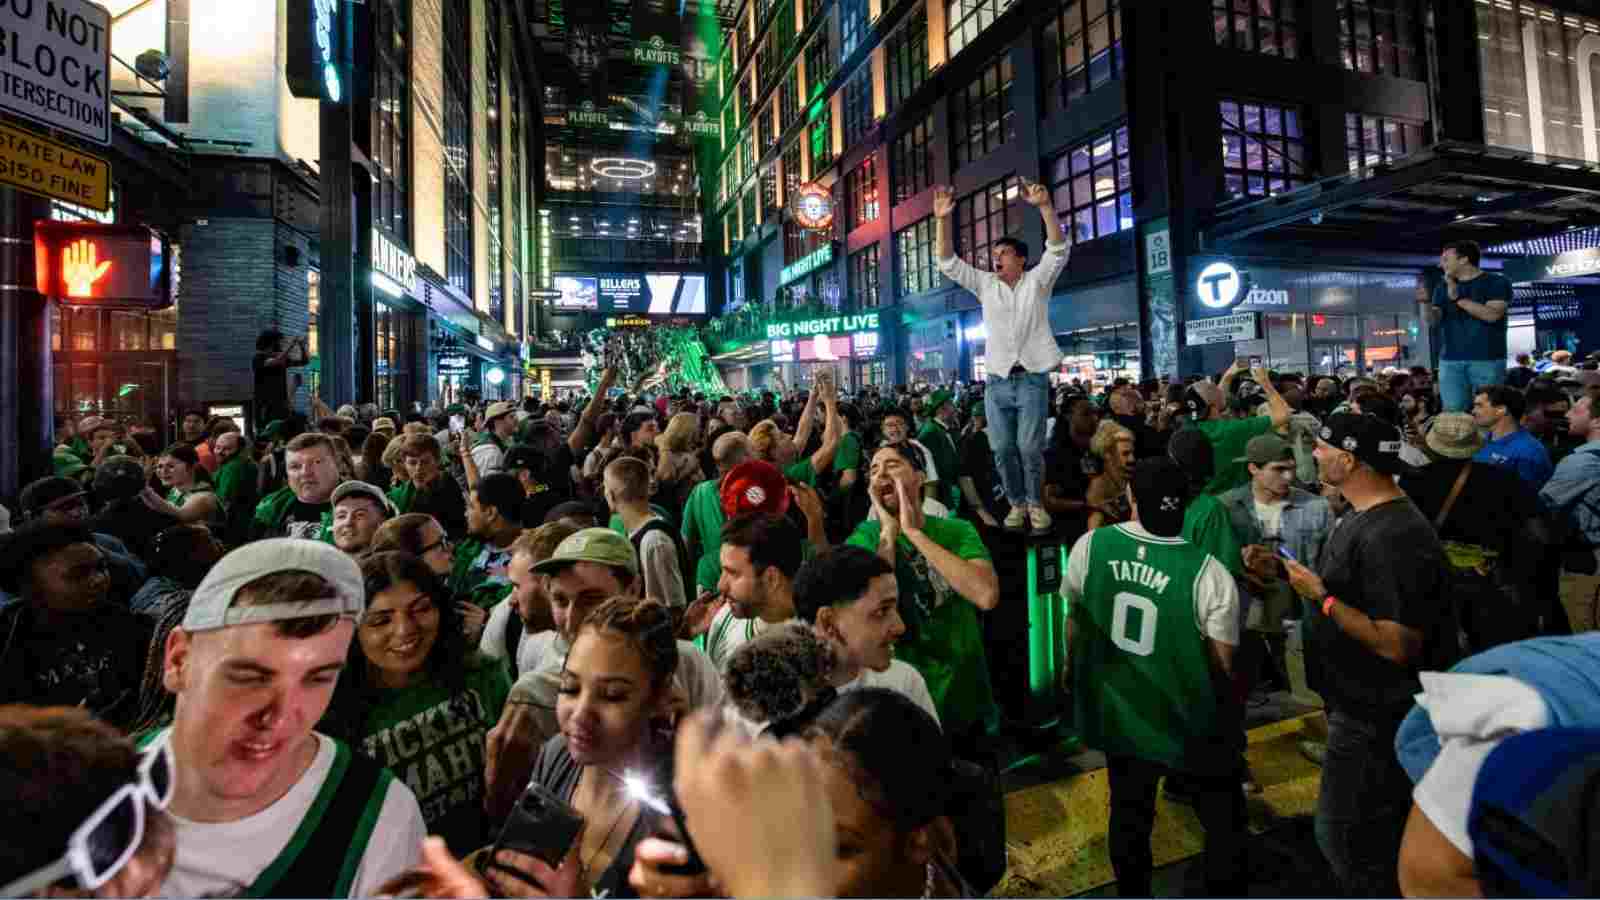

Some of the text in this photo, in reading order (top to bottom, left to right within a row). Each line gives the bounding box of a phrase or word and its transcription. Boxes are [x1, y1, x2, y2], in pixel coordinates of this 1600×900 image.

[46, 1, 104, 54] NOT
[633, 47, 681, 65] PLAYOFFS
[59, 151, 97, 177] LAW
[51, 176, 96, 200] FINE
[812, 243, 832, 268] LIVE
[1151, 250, 1168, 268] 18
[1202, 272, 1232, 303] T
[767, 313, 880, 337] BIG NIGHT LIVE
[1186, 319, 1215, 330] NORTH
[1108, 559, 1171, 595] TATUM
[1111, 591, 1158, 657] 0
